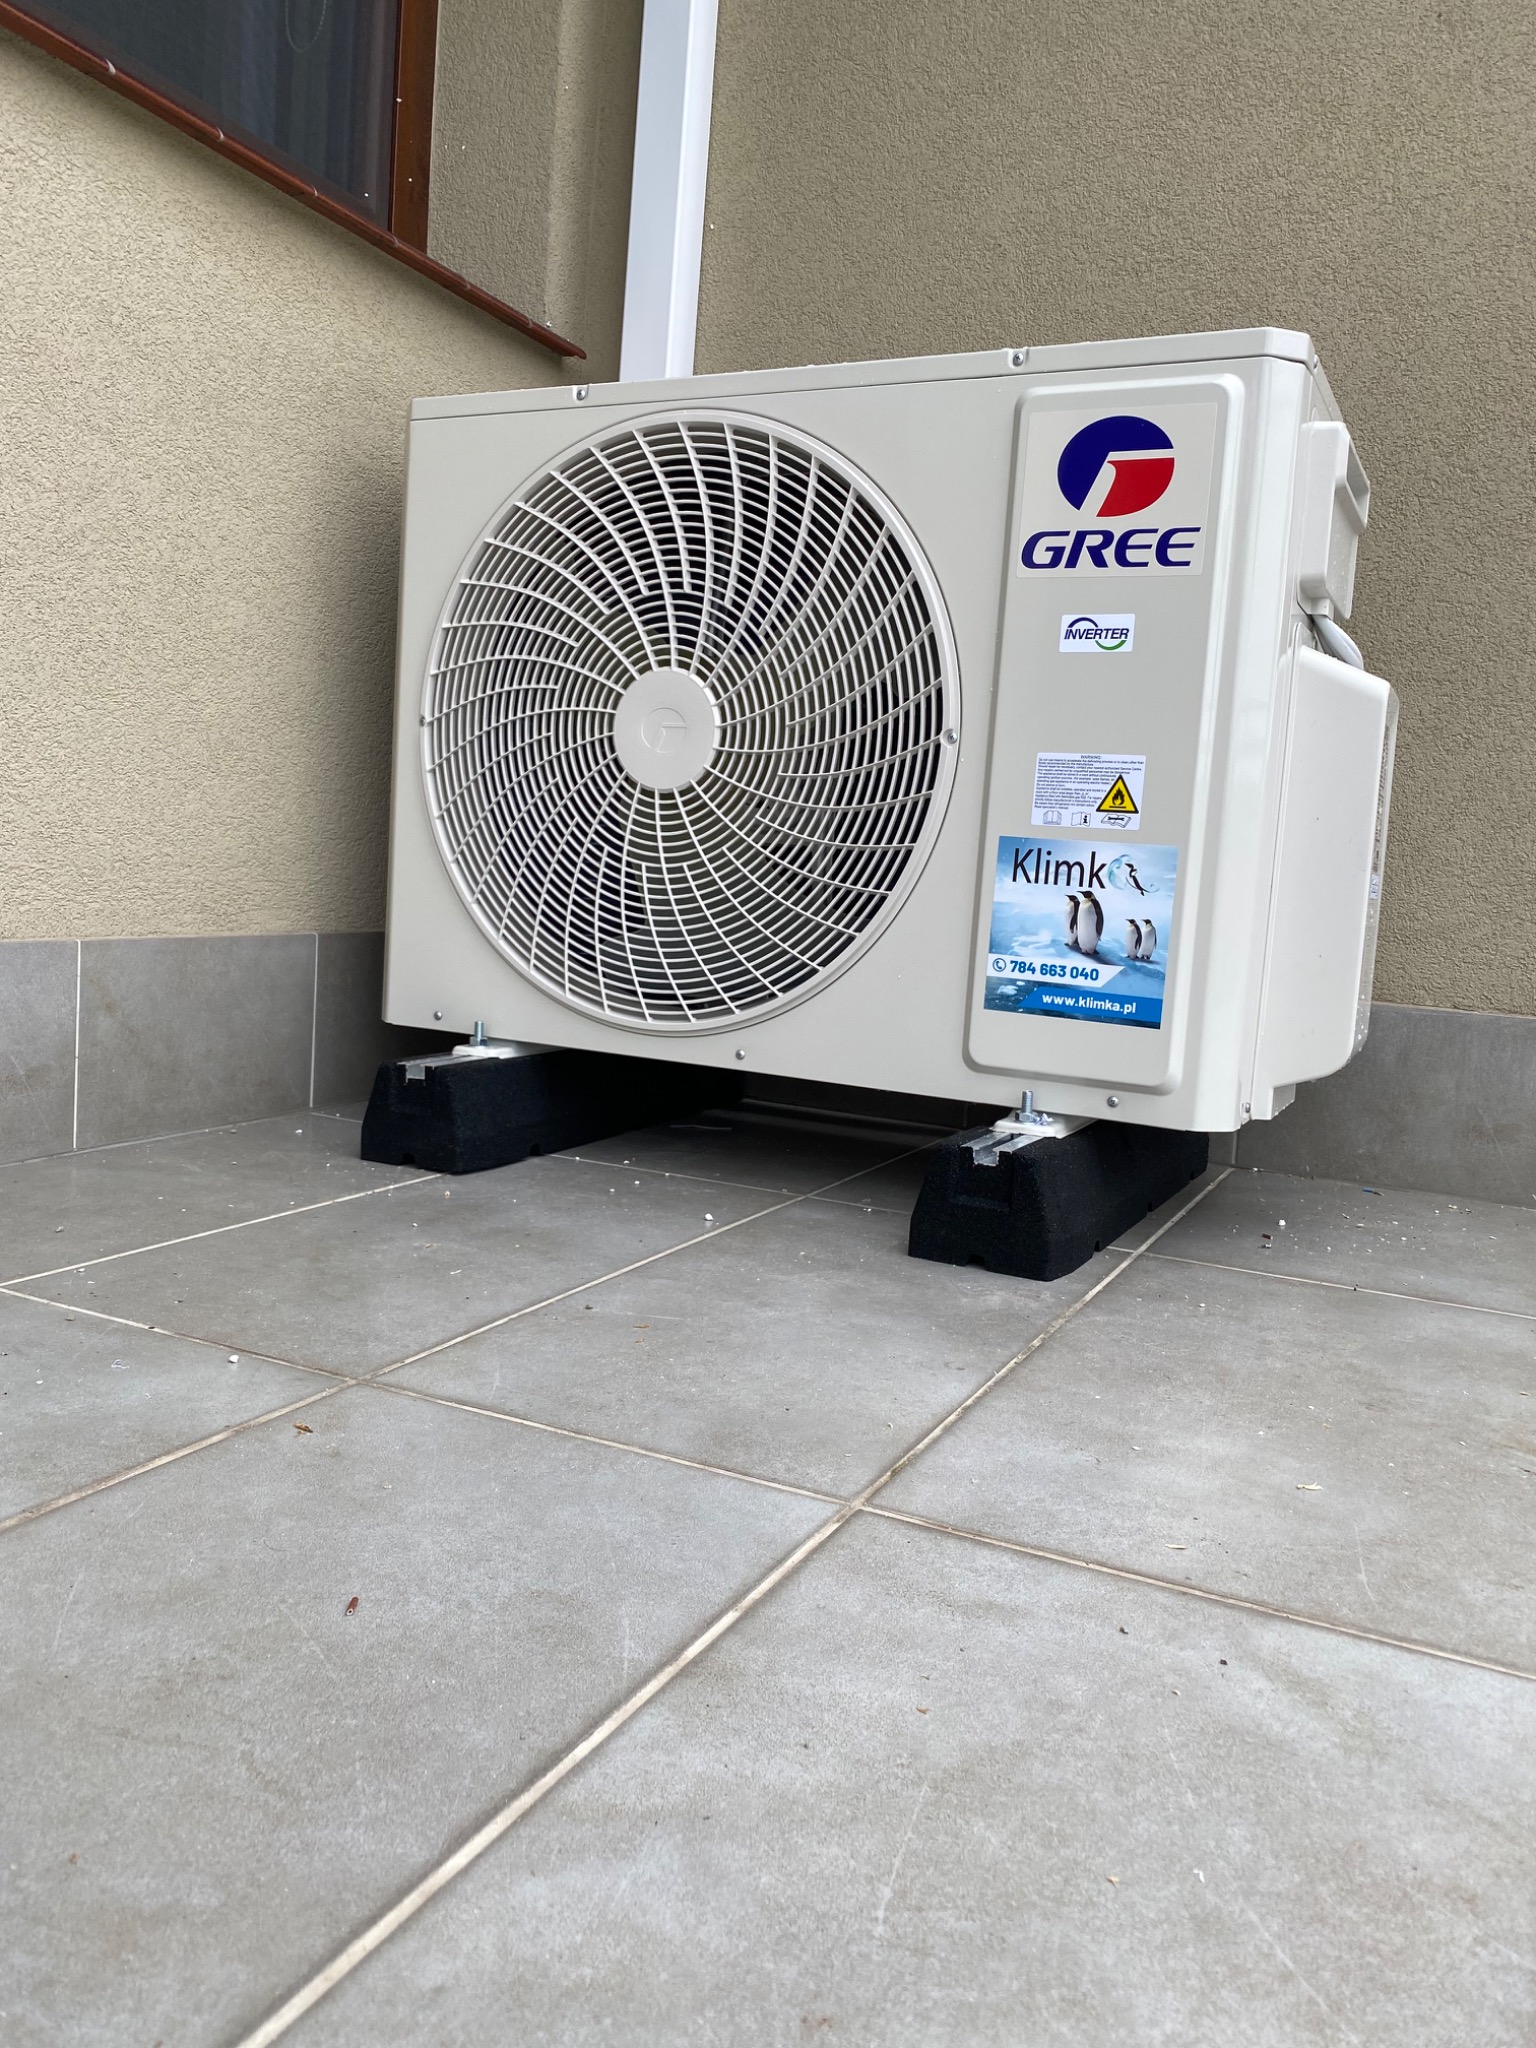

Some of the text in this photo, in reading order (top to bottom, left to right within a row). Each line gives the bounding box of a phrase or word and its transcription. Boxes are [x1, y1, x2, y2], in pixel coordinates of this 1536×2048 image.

[1021, 526, 1202, 569] GREE
[1063, 627, 1130, 640] INVERTER
[1009, 960, 1100, 981] 784 663 040
[1041, 993, 1137, 1014] www.klimka.pl
